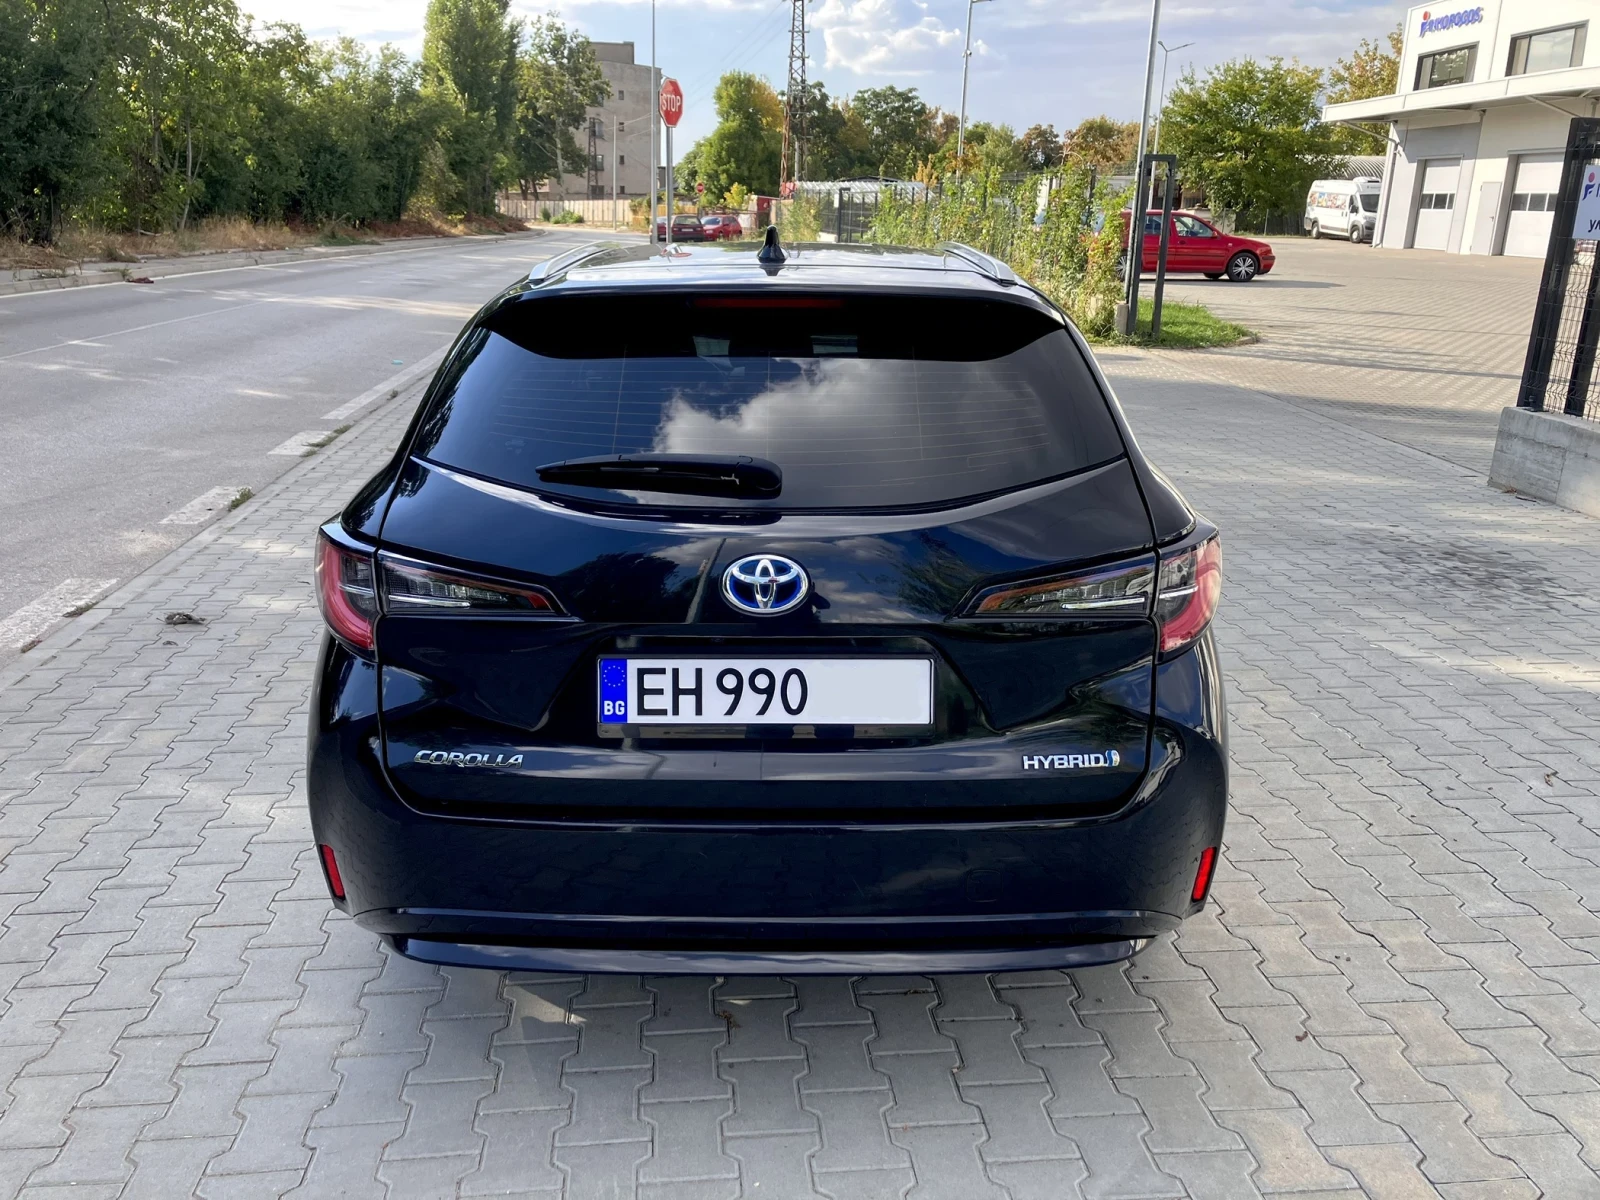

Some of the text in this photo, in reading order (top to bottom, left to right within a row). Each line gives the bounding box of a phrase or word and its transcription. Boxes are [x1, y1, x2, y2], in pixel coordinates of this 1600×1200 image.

[661, 93, 681, 112] STOP
[636, 667, 808, 716] EH 990
[603, 700, 625, 716] BG
[413, 749, 524, 769] COROLLA
[1022, 754, 1106, 770] HYBRID
